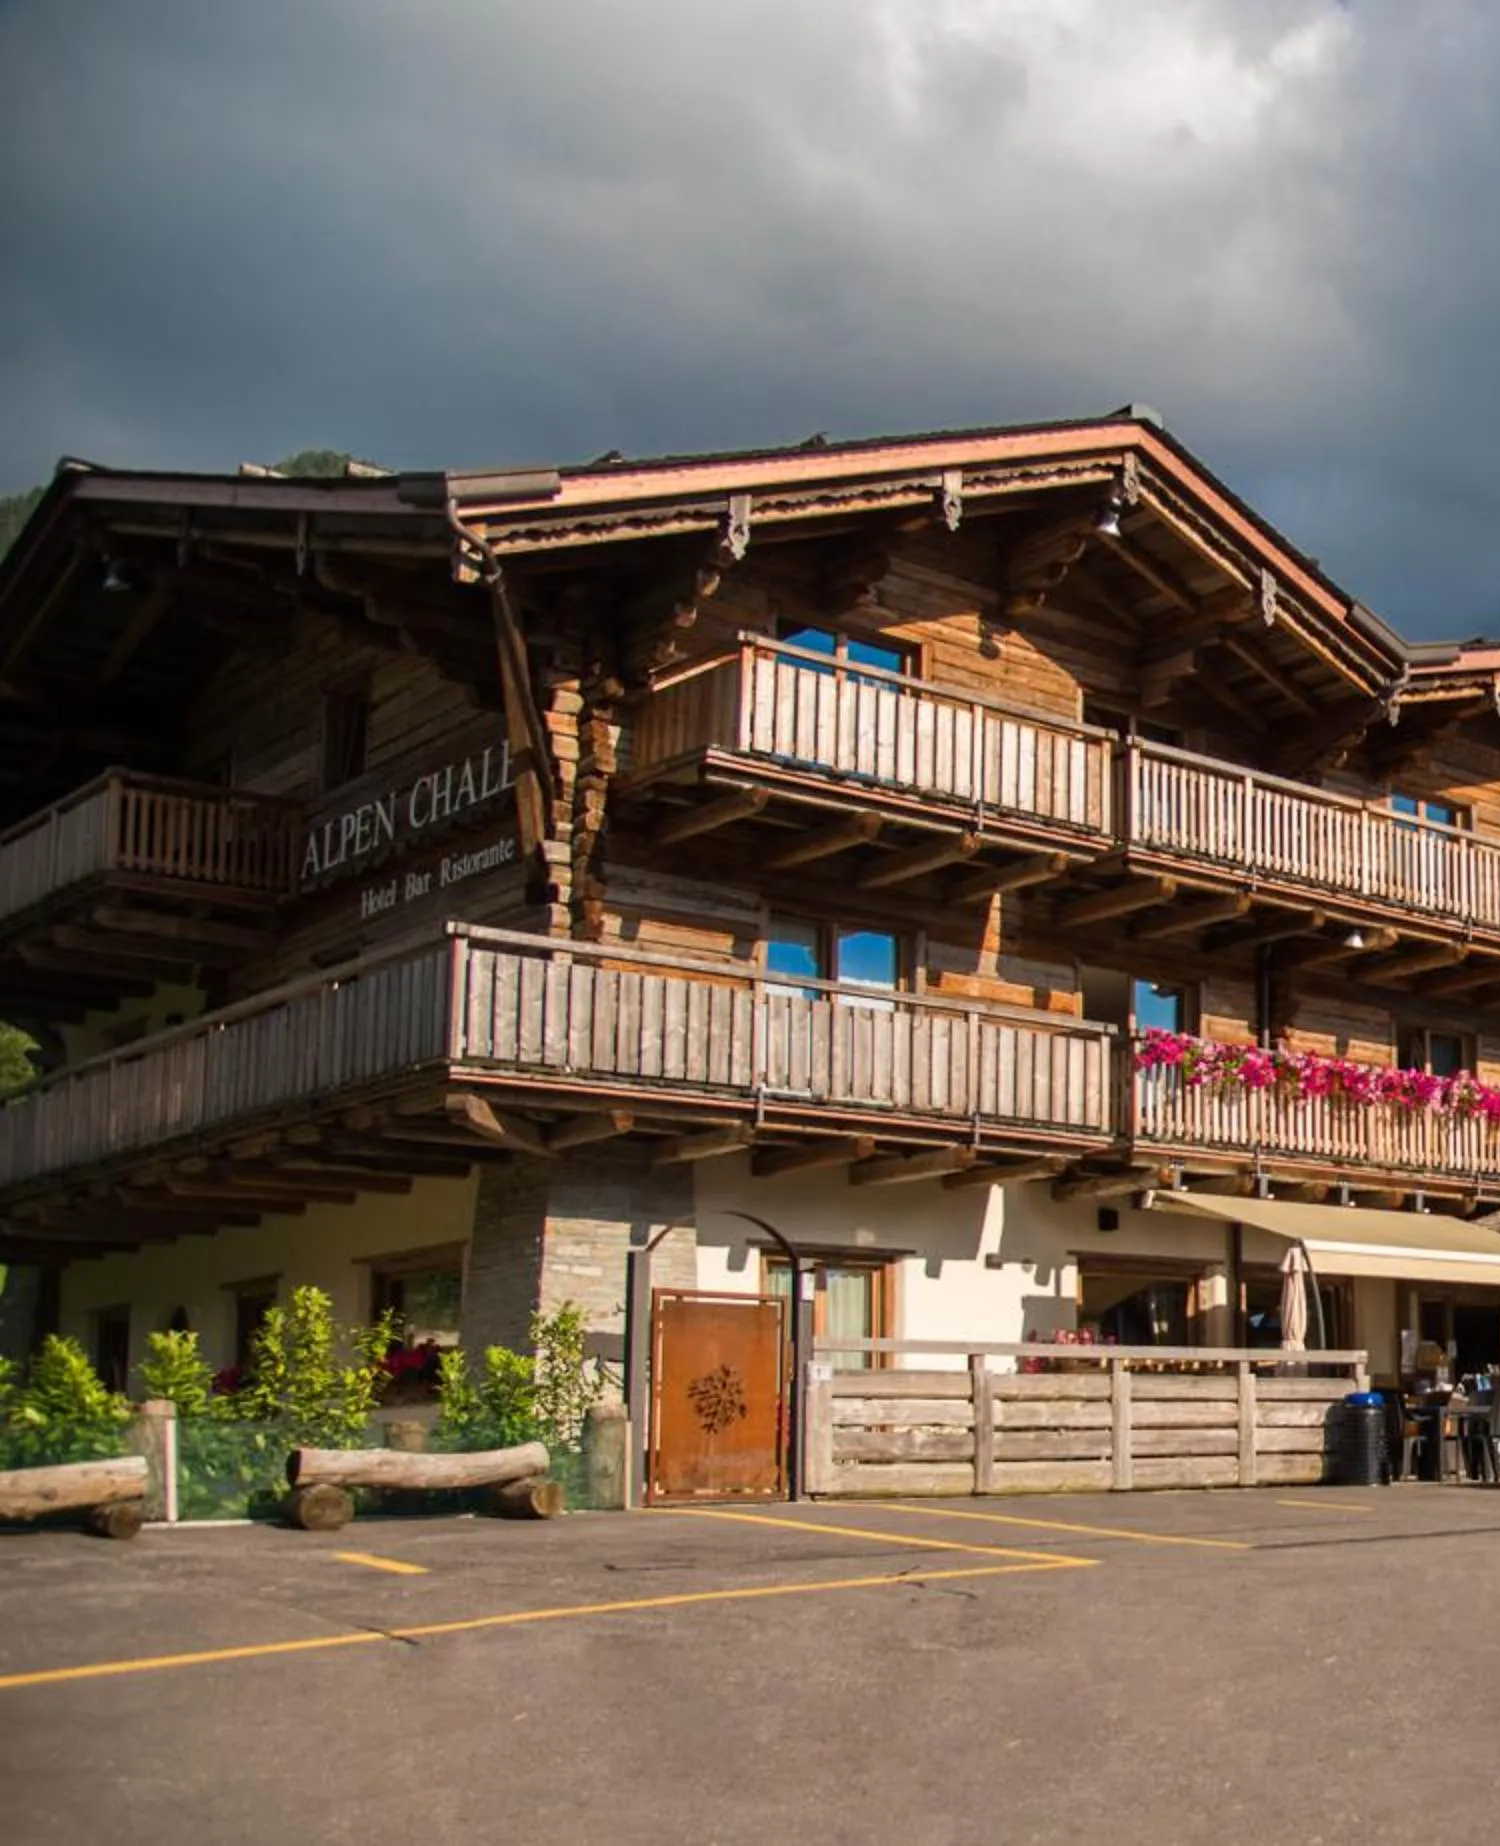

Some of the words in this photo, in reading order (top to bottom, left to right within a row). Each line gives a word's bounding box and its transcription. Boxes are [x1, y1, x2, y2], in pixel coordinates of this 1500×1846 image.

[300, 791, 396, 879] ALPEN
[408, 739, 516, 829] CHALE
[361, 879, 397, 918] Hotel
[405, 872, 432, 900] Bar
[439, 838, 515, 888] Ristorante
